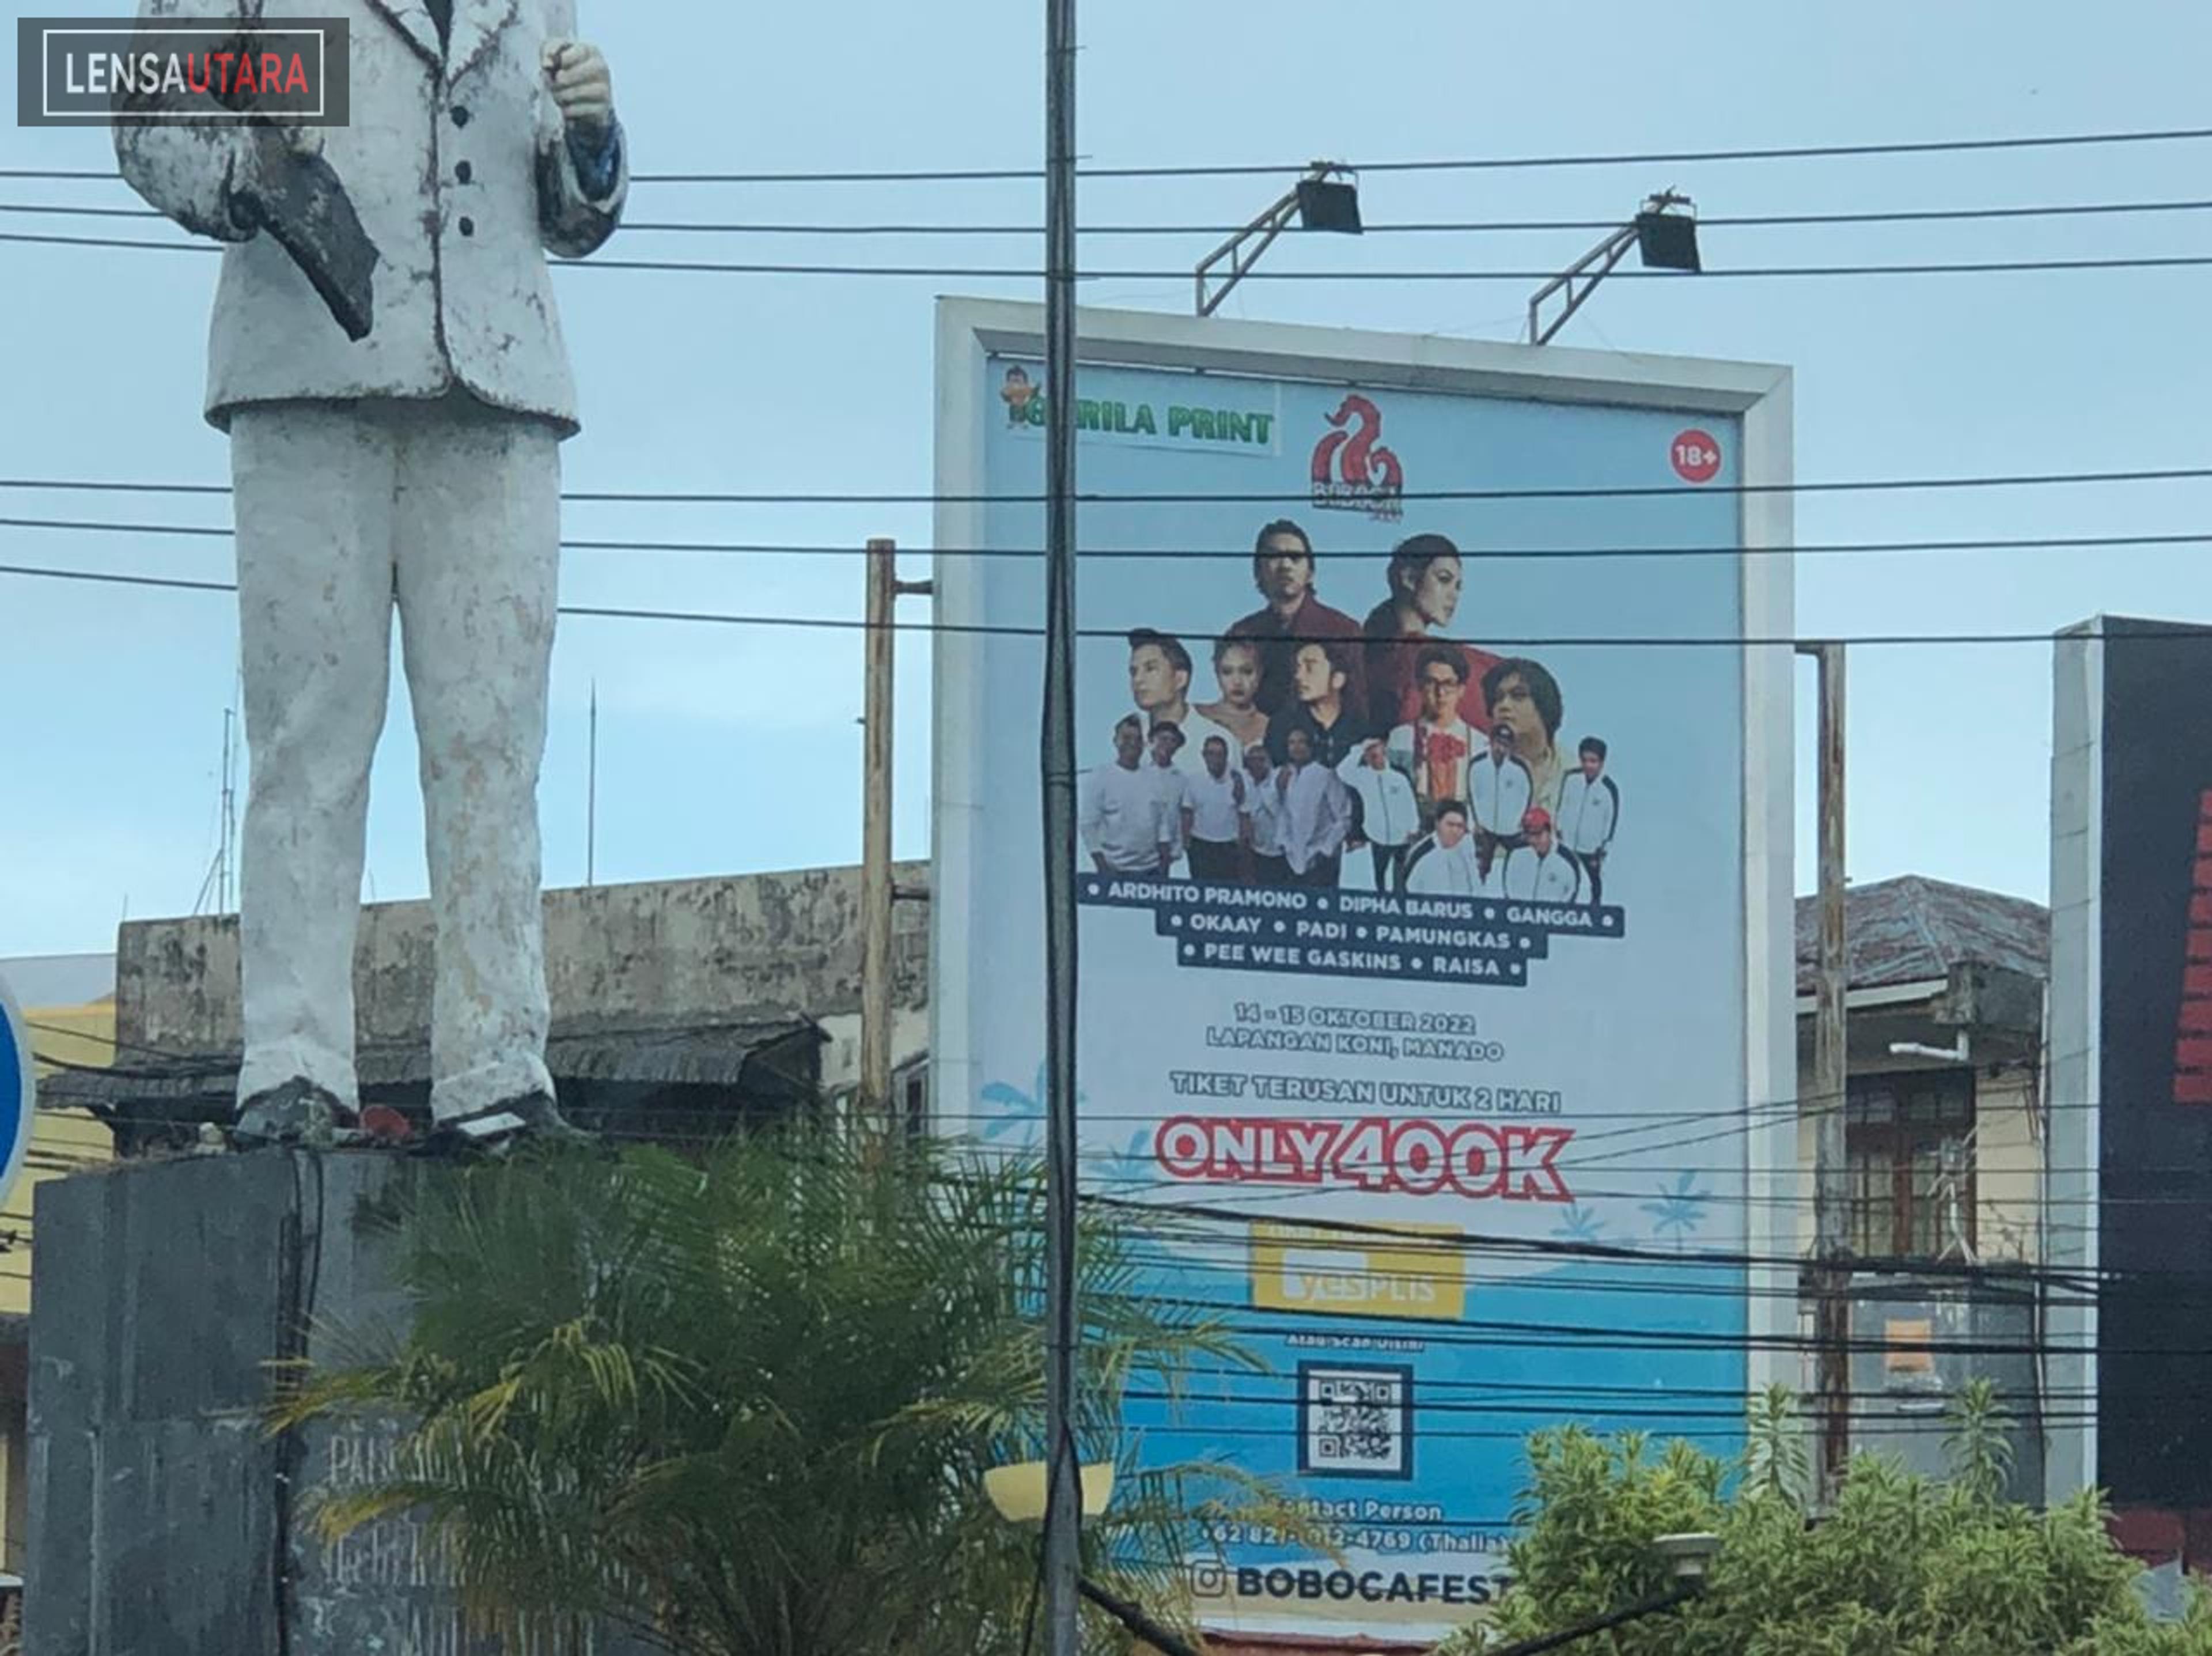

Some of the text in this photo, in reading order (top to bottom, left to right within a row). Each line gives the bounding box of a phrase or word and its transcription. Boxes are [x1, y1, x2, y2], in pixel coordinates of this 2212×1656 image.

[1167, 406, 1274, 444] PRINT
[1675, 444, 1718, 466] 18+
[1108, 882, 1593, 927] ARDHITO PRAMONO DIPHA BARUS GANGGA
[1190, 913, 1510, 950] OKAAY PADI PAMUNGKAS
[1204, 943, 1499, 976] PEE WEE GASKINS RAISA
[1234, 1003, 1259, 1022] 14
[1279, 1005, 1305, 1024] 15
[1308, 1007, 1415, 1030] OKTOBER
[1419, 1013, 1476, 1035] 2022
[1206, 1028, 1505, 1061] LAPANGAN KONI, MANADO
[1169, 1071, 1561, 1113] TIKET TERUSAN UNTUK 2 HARI
[1274, 1500, 1442, 1521] ontact Person
